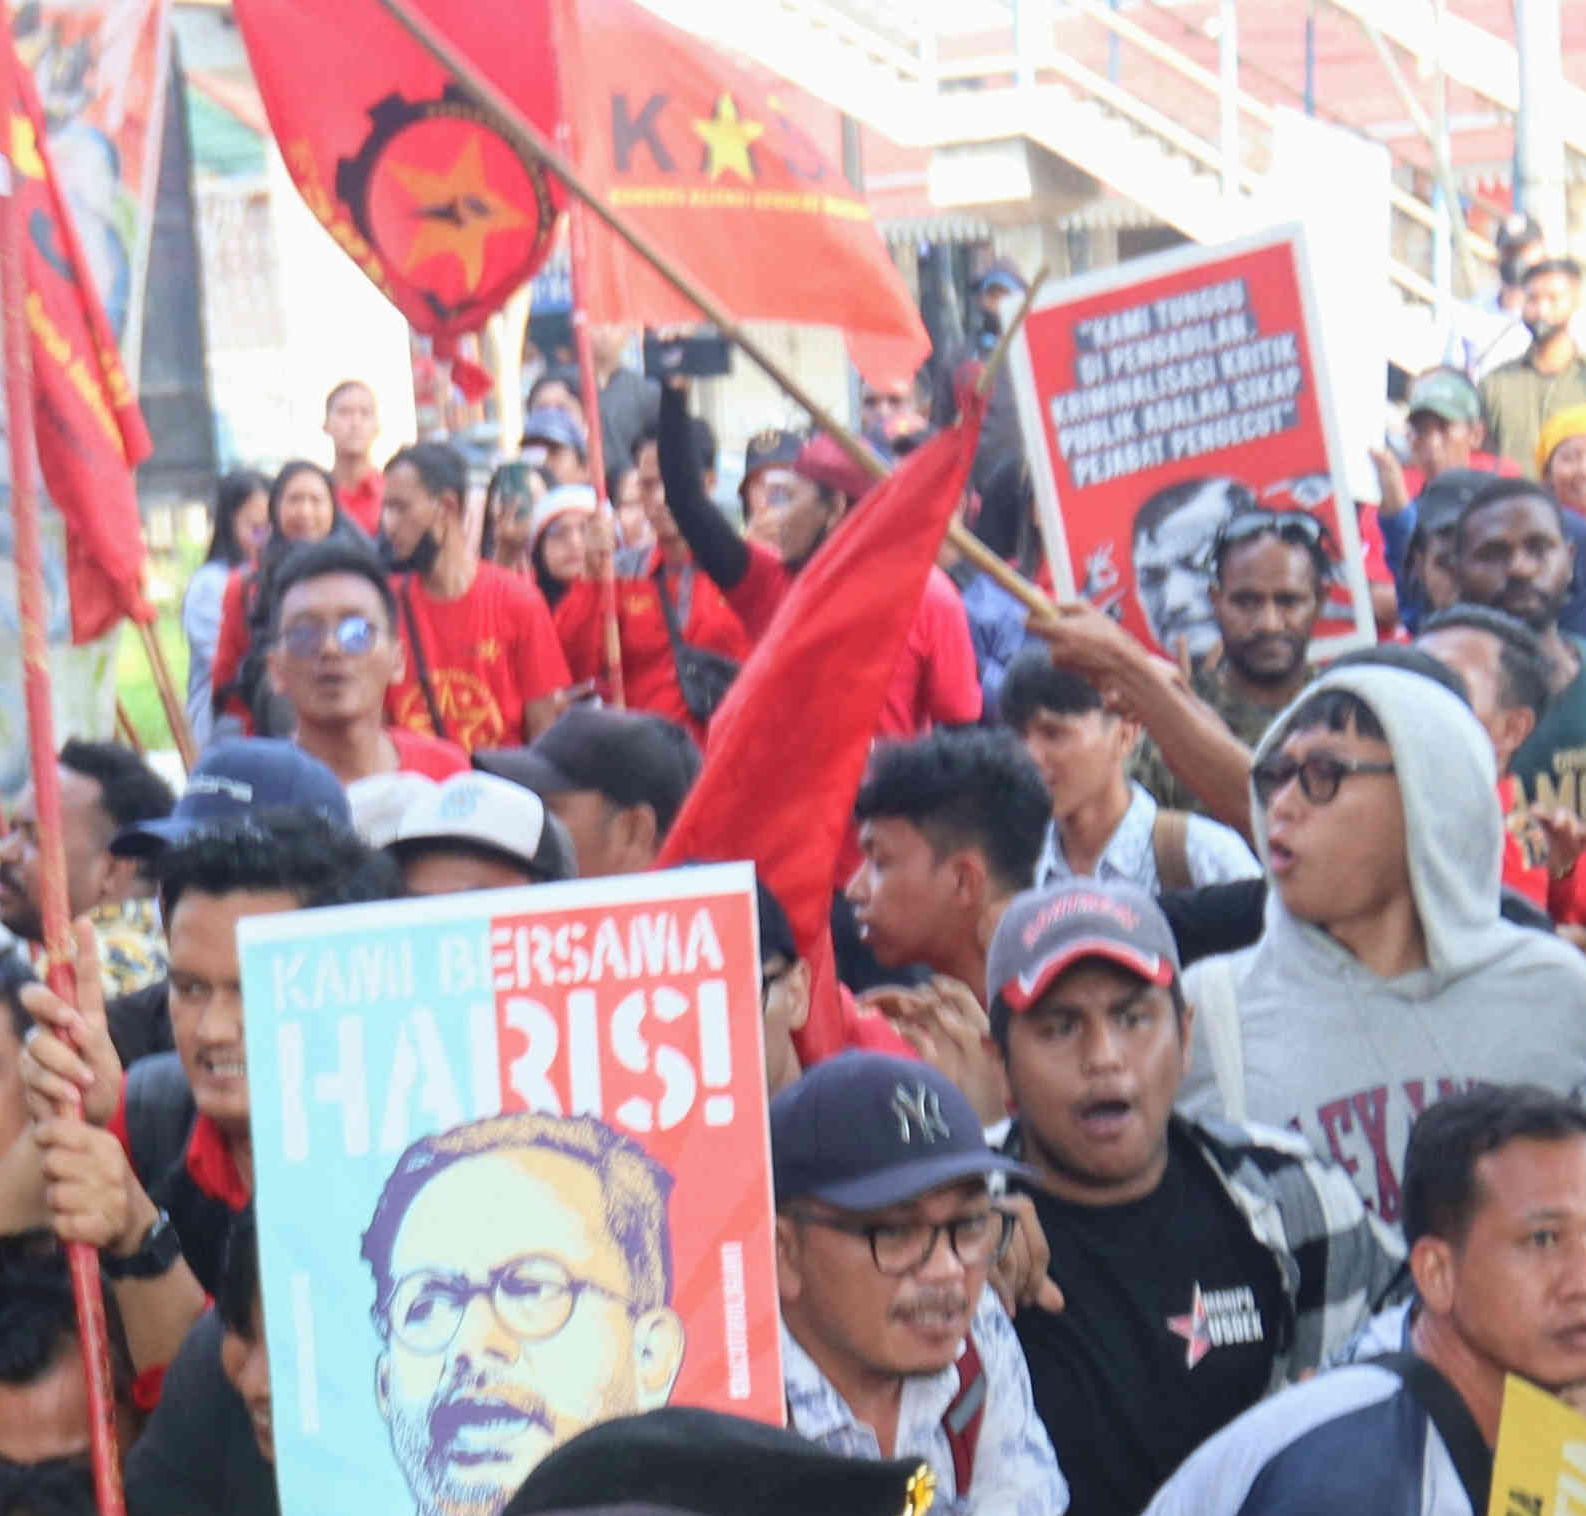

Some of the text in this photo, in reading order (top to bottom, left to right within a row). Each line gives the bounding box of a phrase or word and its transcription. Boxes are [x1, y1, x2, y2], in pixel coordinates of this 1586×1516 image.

[271, 907, 725, 1011] KAMI BERSAMA
[276, 978, 735, 1161] HARIS!
[892, 1081, 951, 1145] NY
